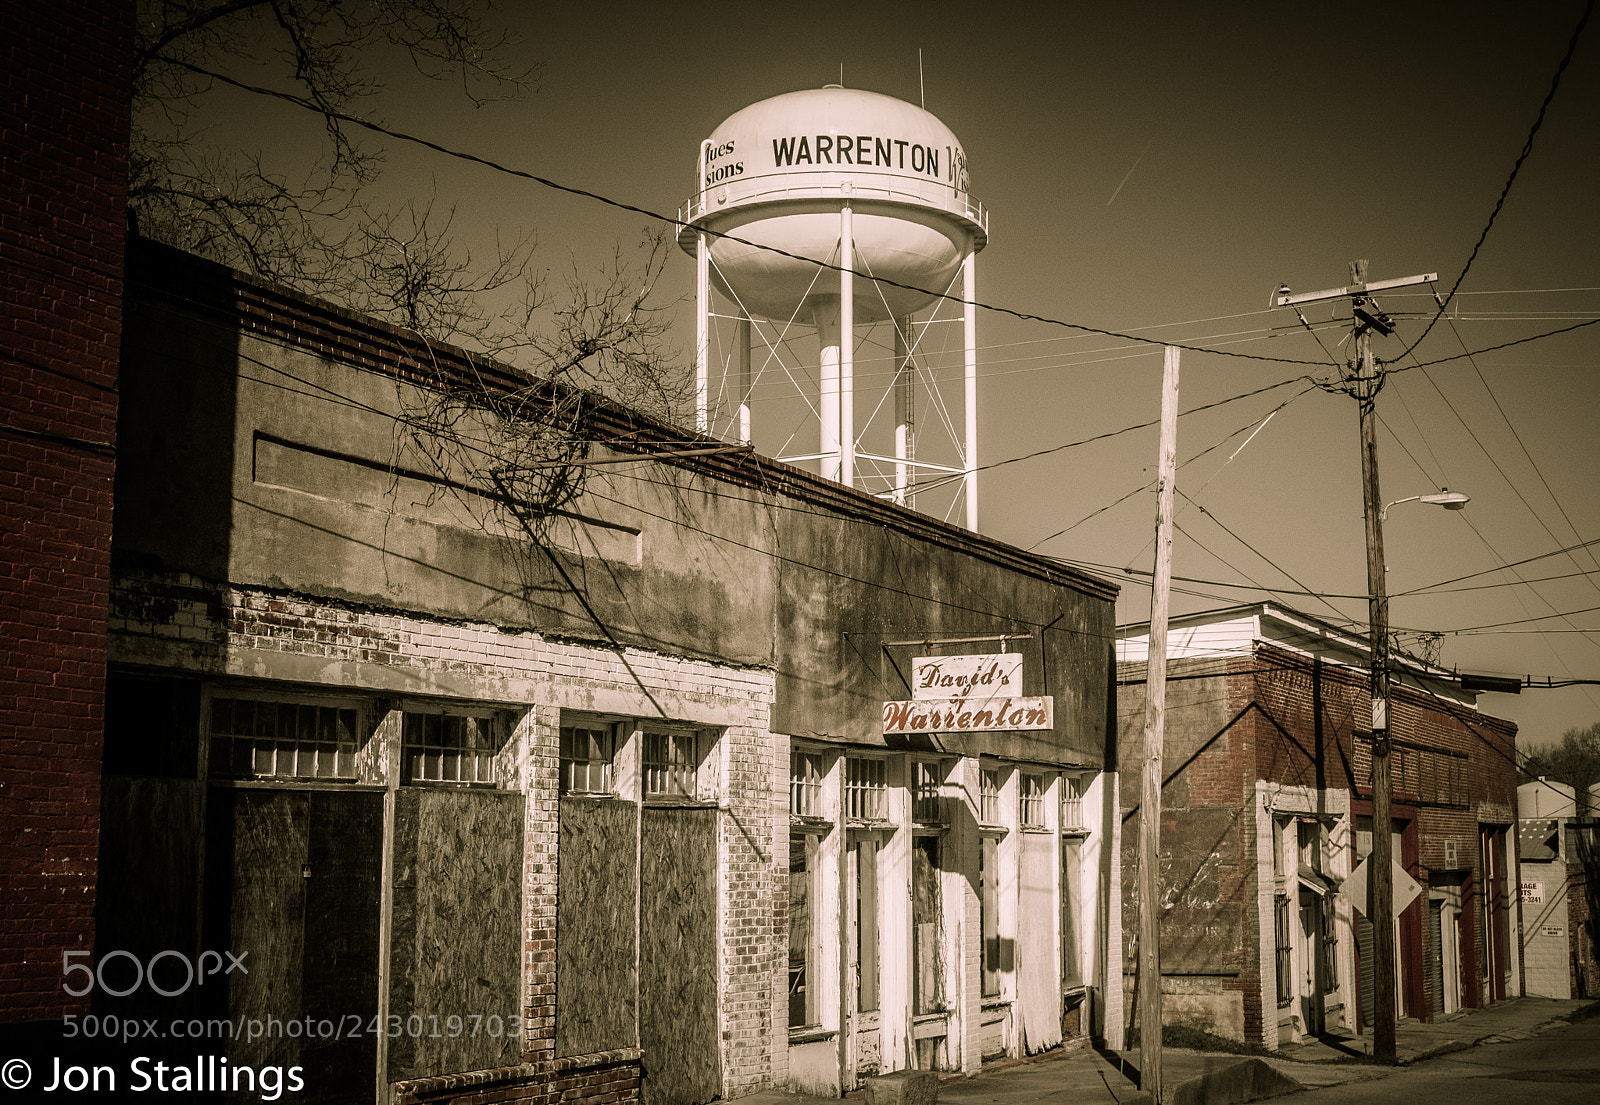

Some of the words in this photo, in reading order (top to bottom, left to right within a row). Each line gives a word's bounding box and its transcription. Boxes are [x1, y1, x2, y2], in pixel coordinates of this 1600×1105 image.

[772, 135, 939, 178] WARRENTON
[919, 662, 1010, 689] David's
[883, 699, 1047, 732] Warrenton
